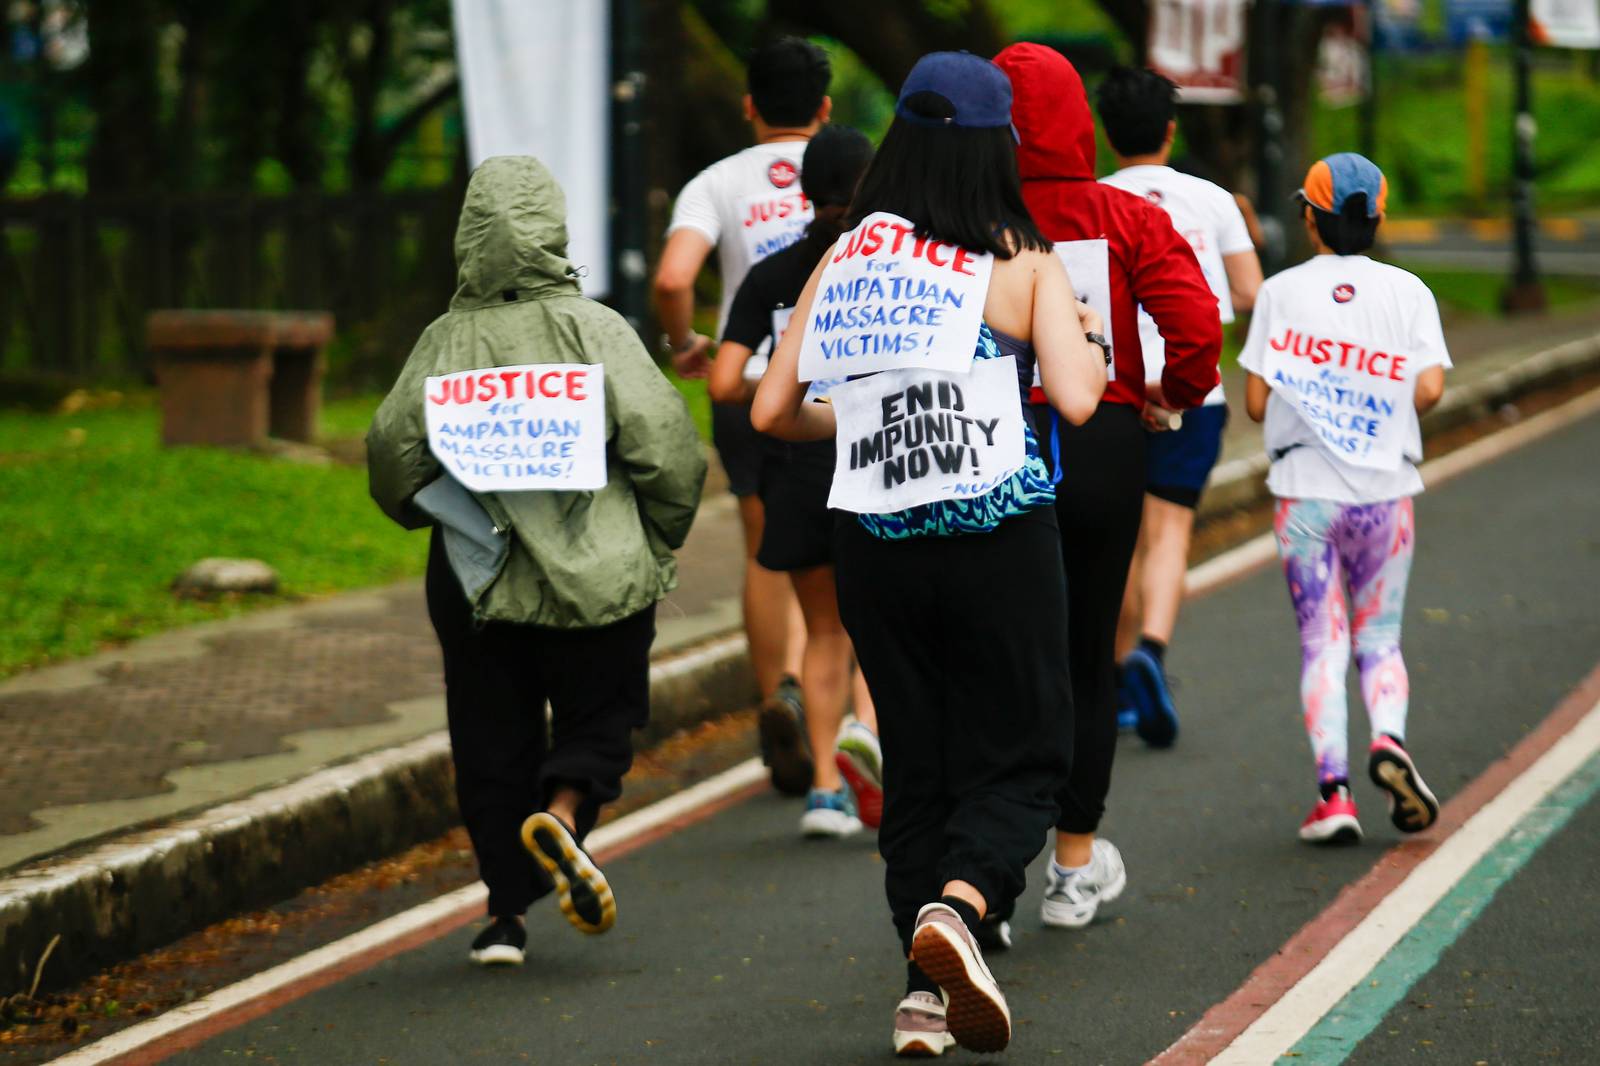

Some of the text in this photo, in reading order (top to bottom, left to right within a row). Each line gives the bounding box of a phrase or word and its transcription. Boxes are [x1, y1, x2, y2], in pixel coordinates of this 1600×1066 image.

[833, 220, 979, 277] JUSTICE
[866, 259, 900, 272] for
[820, 277, 965, 309] AMPATUAN
[814, 304, 947, 333] MASSACRE
[1269, 328, 1408, 382] JUSTICE
[428, 370, 588, 405] JUSTICE
[881, 379, 966, 427] END
[488, 402, 525, 415] for
[439, 418, 581, 440] AMPATUAN
[850, 412, 1000, 471] IMPUNITY
[439, 438, 575, 461] MASSACRE
[455, 457, 575, 479] VICTIMS!
[883, 443, 981, 490] NOW!
